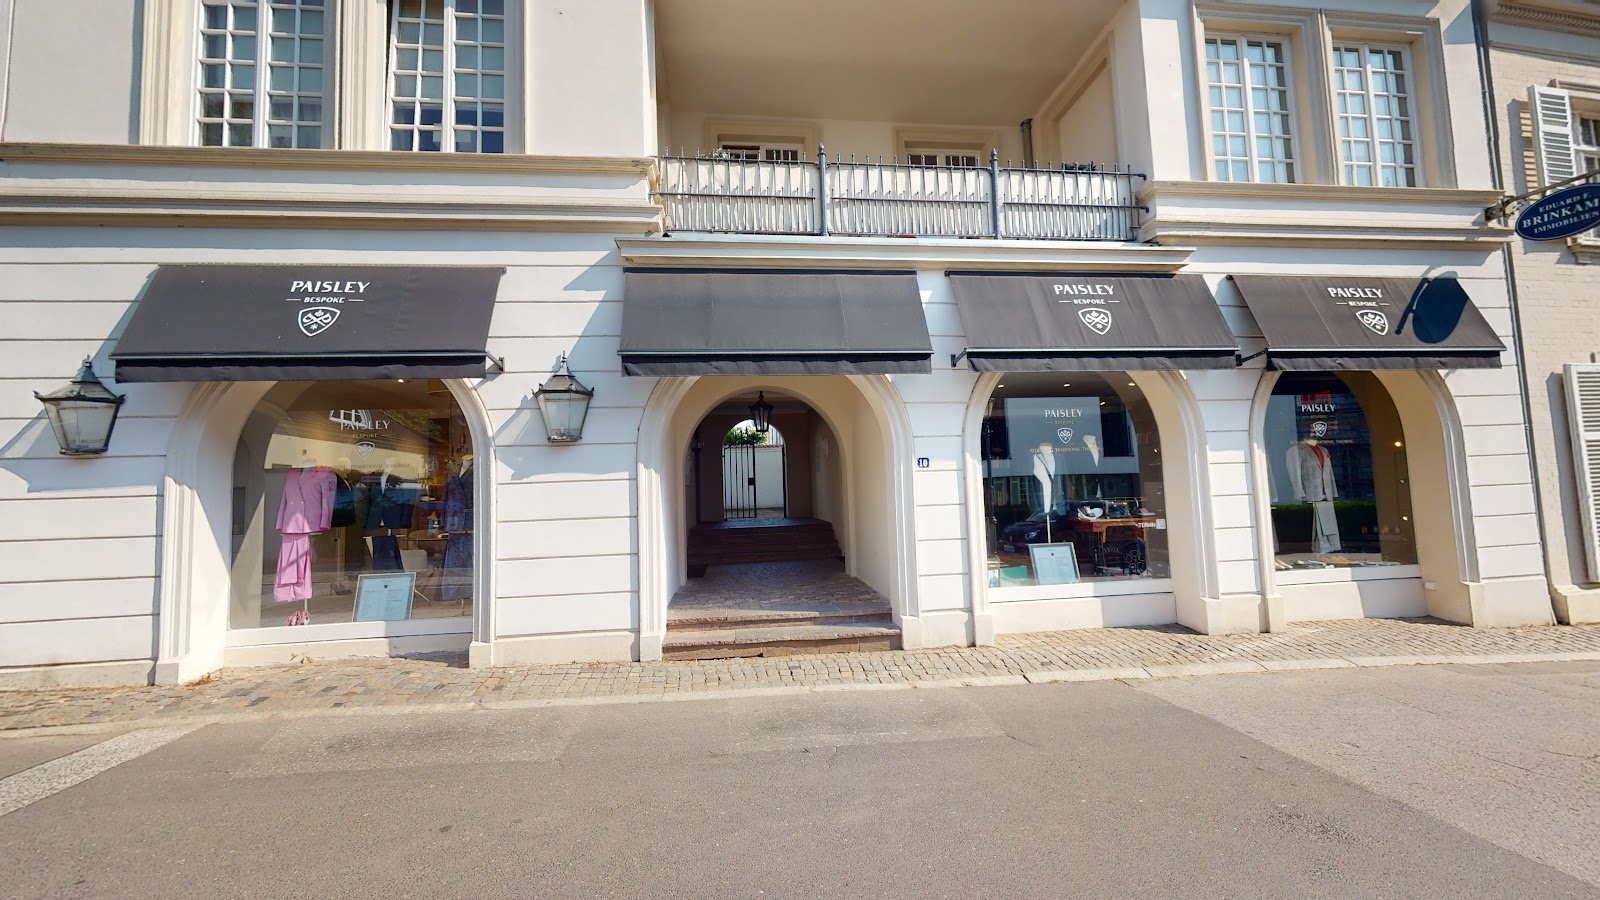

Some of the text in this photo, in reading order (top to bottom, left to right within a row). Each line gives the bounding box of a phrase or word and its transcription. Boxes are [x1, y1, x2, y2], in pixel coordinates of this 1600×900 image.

[1539, 195, 1580, 212] EDUARD
[1533, 210, 1600, 234] IMMOBILIEN
[290, 280, 370, 293] PAISLEY
[1053, 284, 1114, 295] PAISLEY
[1327, 287, 1383, 298] PAISLEY
[1044, 409, 1083, 418] PAISLEY
[1301, 404, 1335, 413] PAISLEY
[340, 420, 391, 431] PAISLEY
[919, 458, 928, 468] 10
